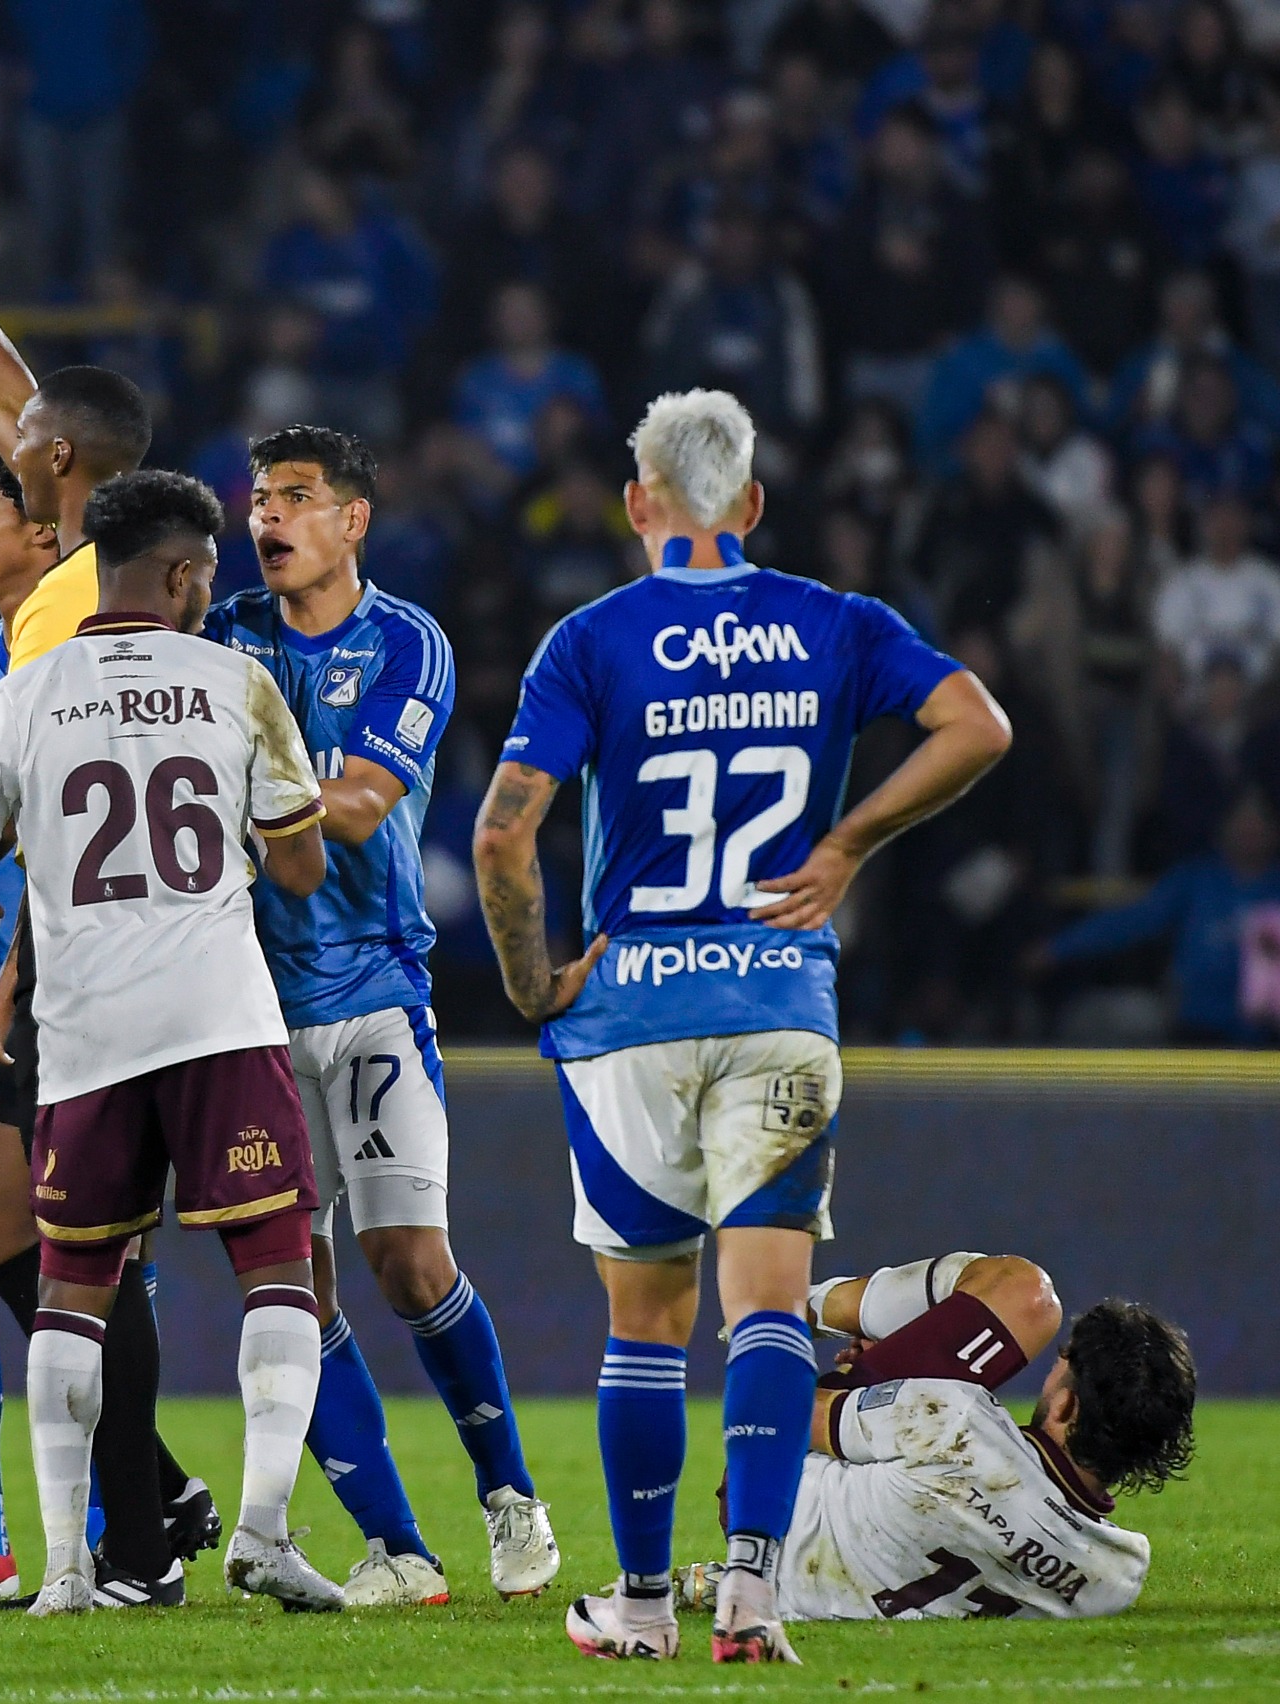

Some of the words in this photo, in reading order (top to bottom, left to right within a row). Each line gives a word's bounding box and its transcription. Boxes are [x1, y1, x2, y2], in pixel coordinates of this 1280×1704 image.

[51, 700, 115, 726] TAPA
[117, 686, 216, 725] ROJA
[645, 690, 819, 738] GIORDANA
[61, 755, 224, 907] 26
[629, 745, 811, 912] 32
[616, 938, 803, 986] Wplay.co
[349, 1053, 401, 1124] 17
[227, 1141, 282, 1173] ROJA
[238, 1129, 269, 1141] TAPA
[957, 1328, 1004, 1374] 11
[966, 1487, 1016, 1547] TAPA
[1004, 1537, 1088, 1606] ROJA
